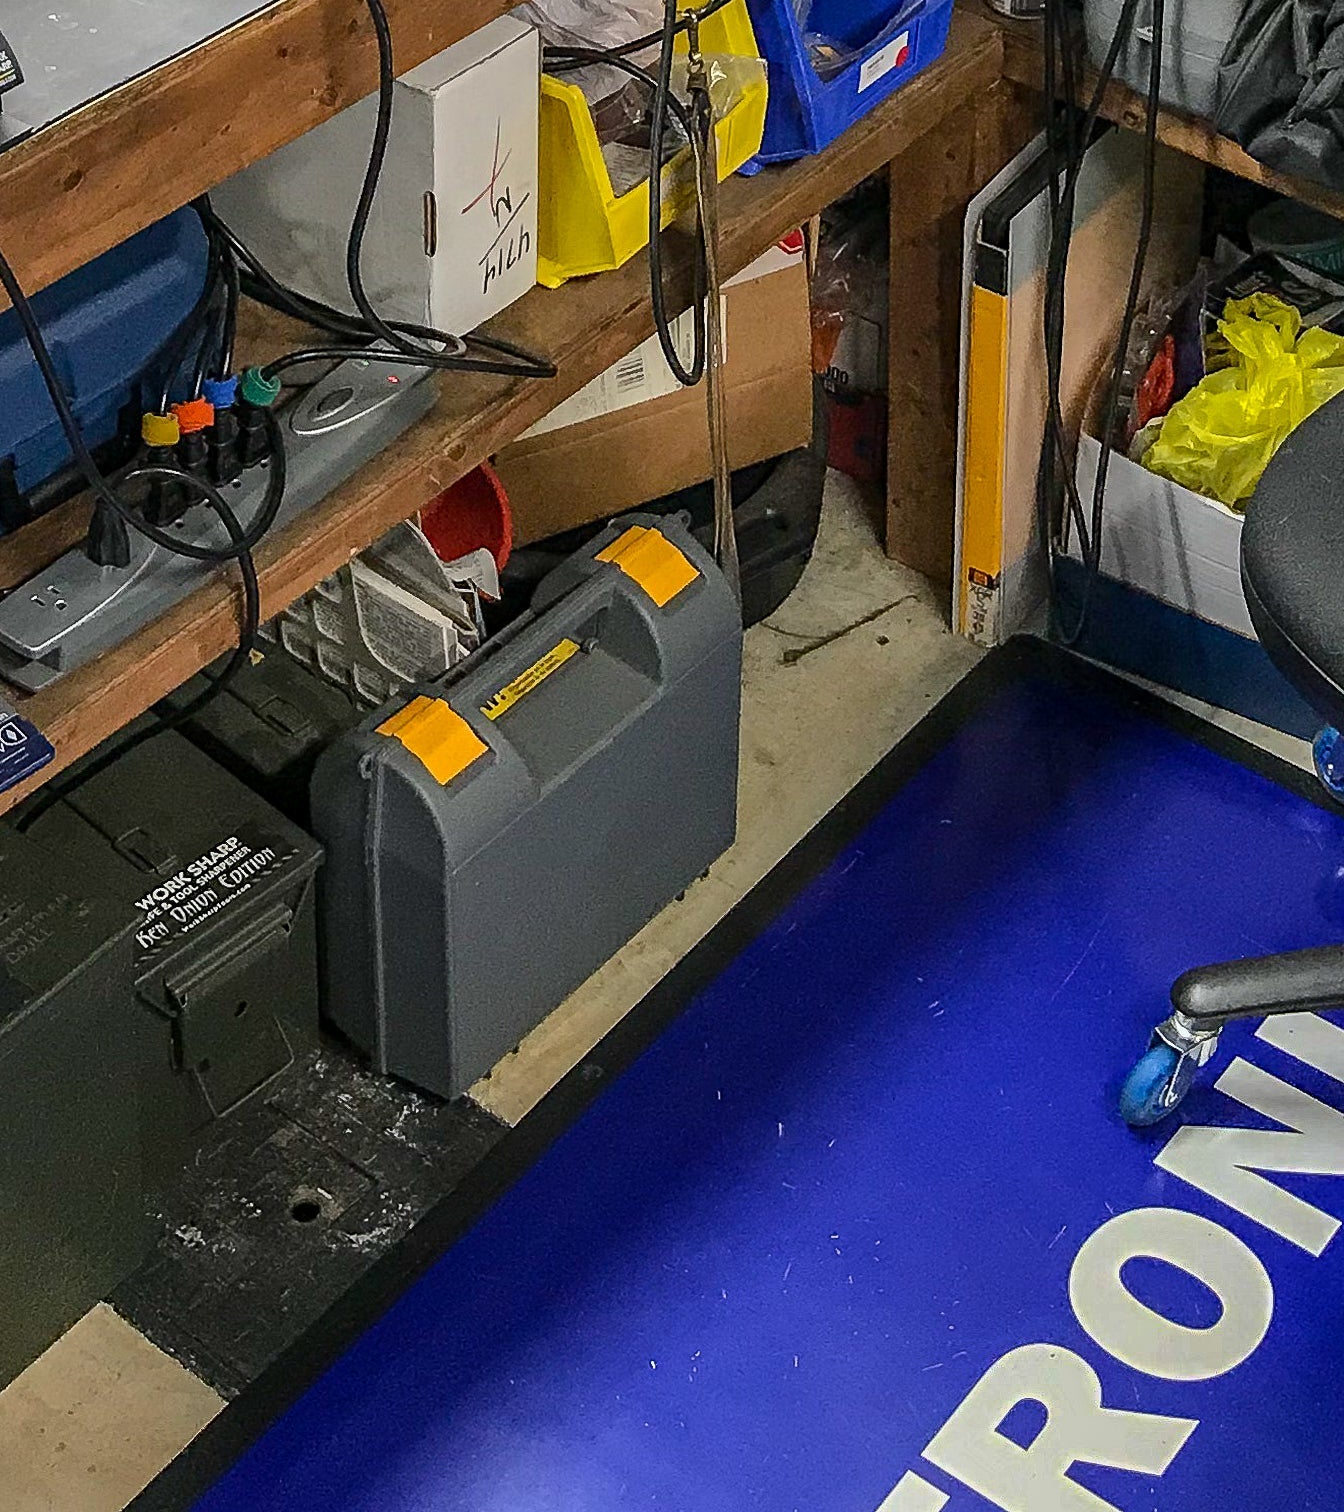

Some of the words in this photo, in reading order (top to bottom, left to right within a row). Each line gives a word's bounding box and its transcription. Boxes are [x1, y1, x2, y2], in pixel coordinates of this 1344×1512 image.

[134, 871, 192, 911] WORK
[187, 836, 239, 877] SHARP
[160, 901, 173, 912] &
[169, 883, 199, 904] TOOL
[195, 845, 252, 887] SHARPENER
